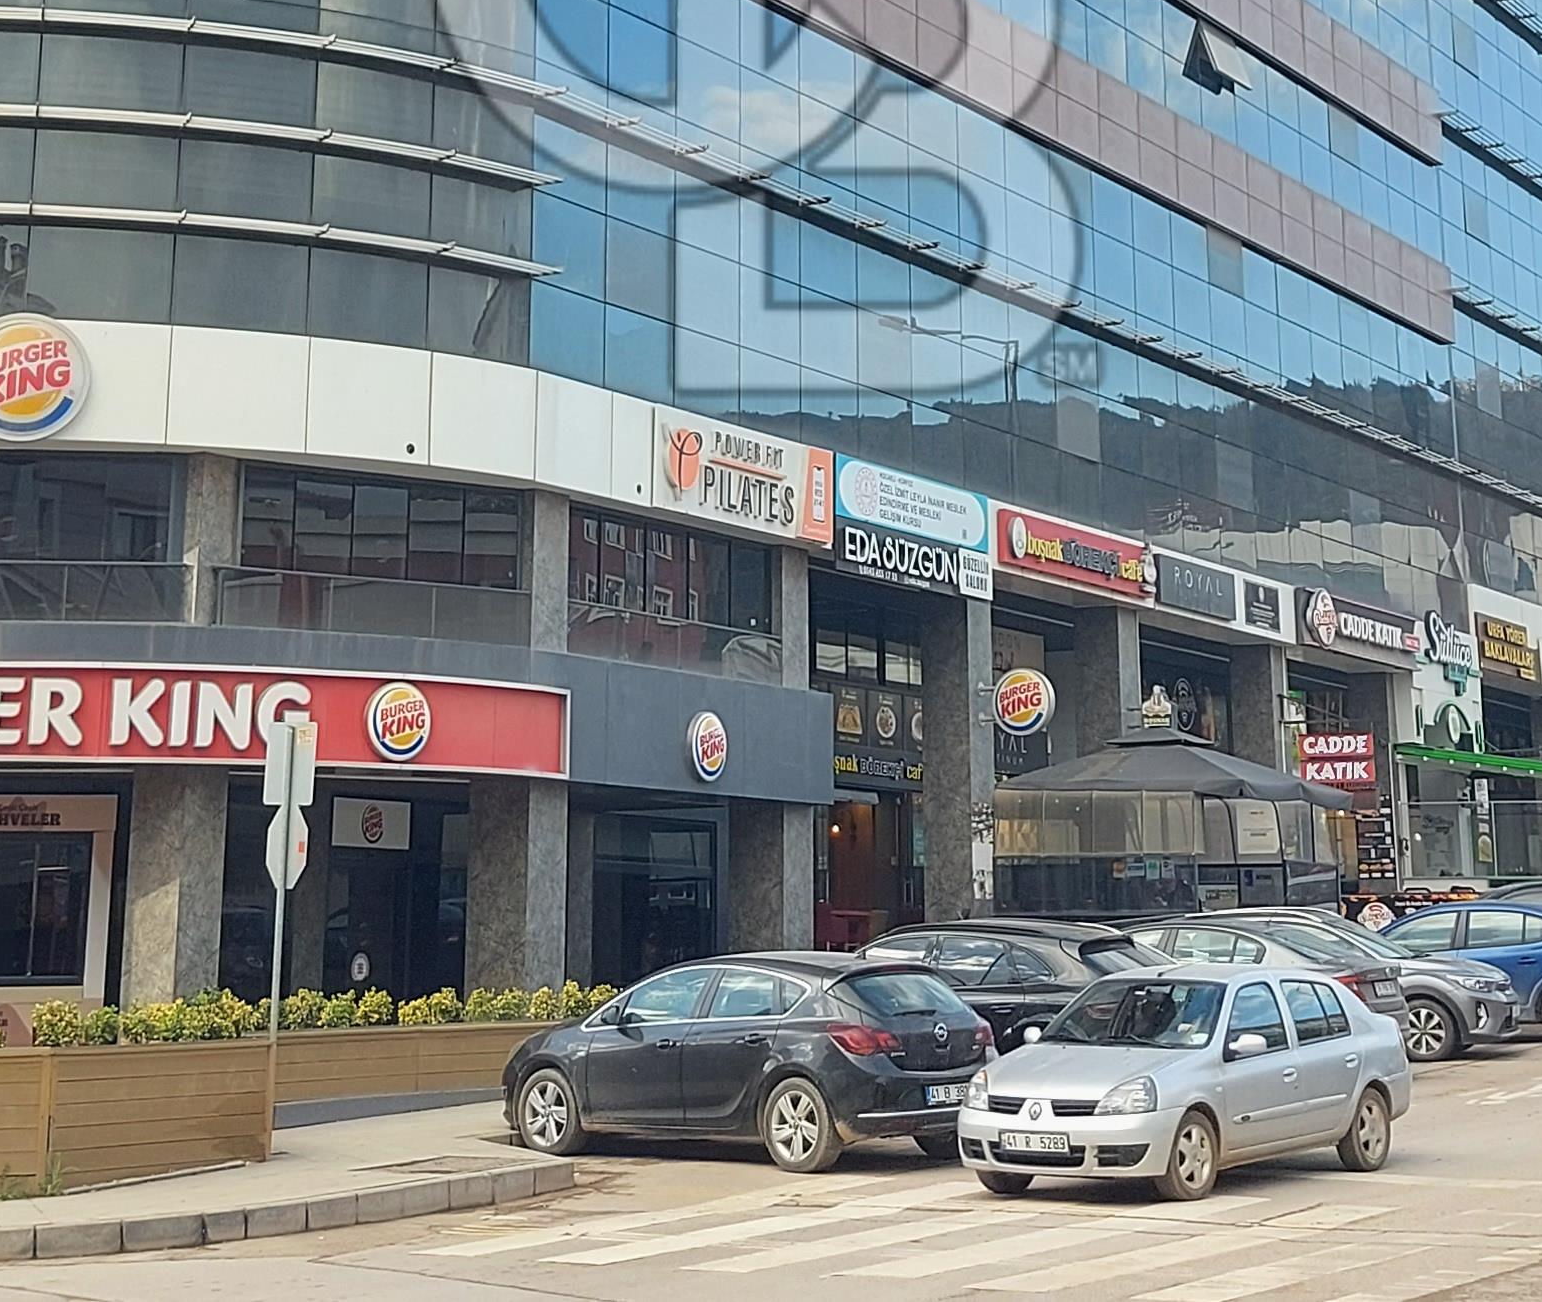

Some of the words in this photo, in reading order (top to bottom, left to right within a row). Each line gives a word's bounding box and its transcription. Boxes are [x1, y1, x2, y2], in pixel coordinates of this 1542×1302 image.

[703, 465, 795, 525] PILATES
[844, 526, 885, 567] EDA
[882, 536, 958, 585] SÜZGÜN
[1173, 566, 1223, 596] ROYAL
[1340, 612, 1375, 643] CADDE
[999, 681, 1041, 703] BURGER
[110, 678, 312, 751] KING
[380, 699, 425, 722] BURGER
[1000, 692, 1042, 719] KING
[381, 712, 426, 740] KING
[700, 737, 725, 763] KING
[1302, 734, 1368, 755] CADDE
[1305, 762, 1369, 781] KATIK
[931, 1087, 940, 1100] 41
[1006, 1135, 1017, 1148] 41
[1024, 1136, 1031, 1148] R
[1039, 1136, 1065, 1150] 5289
